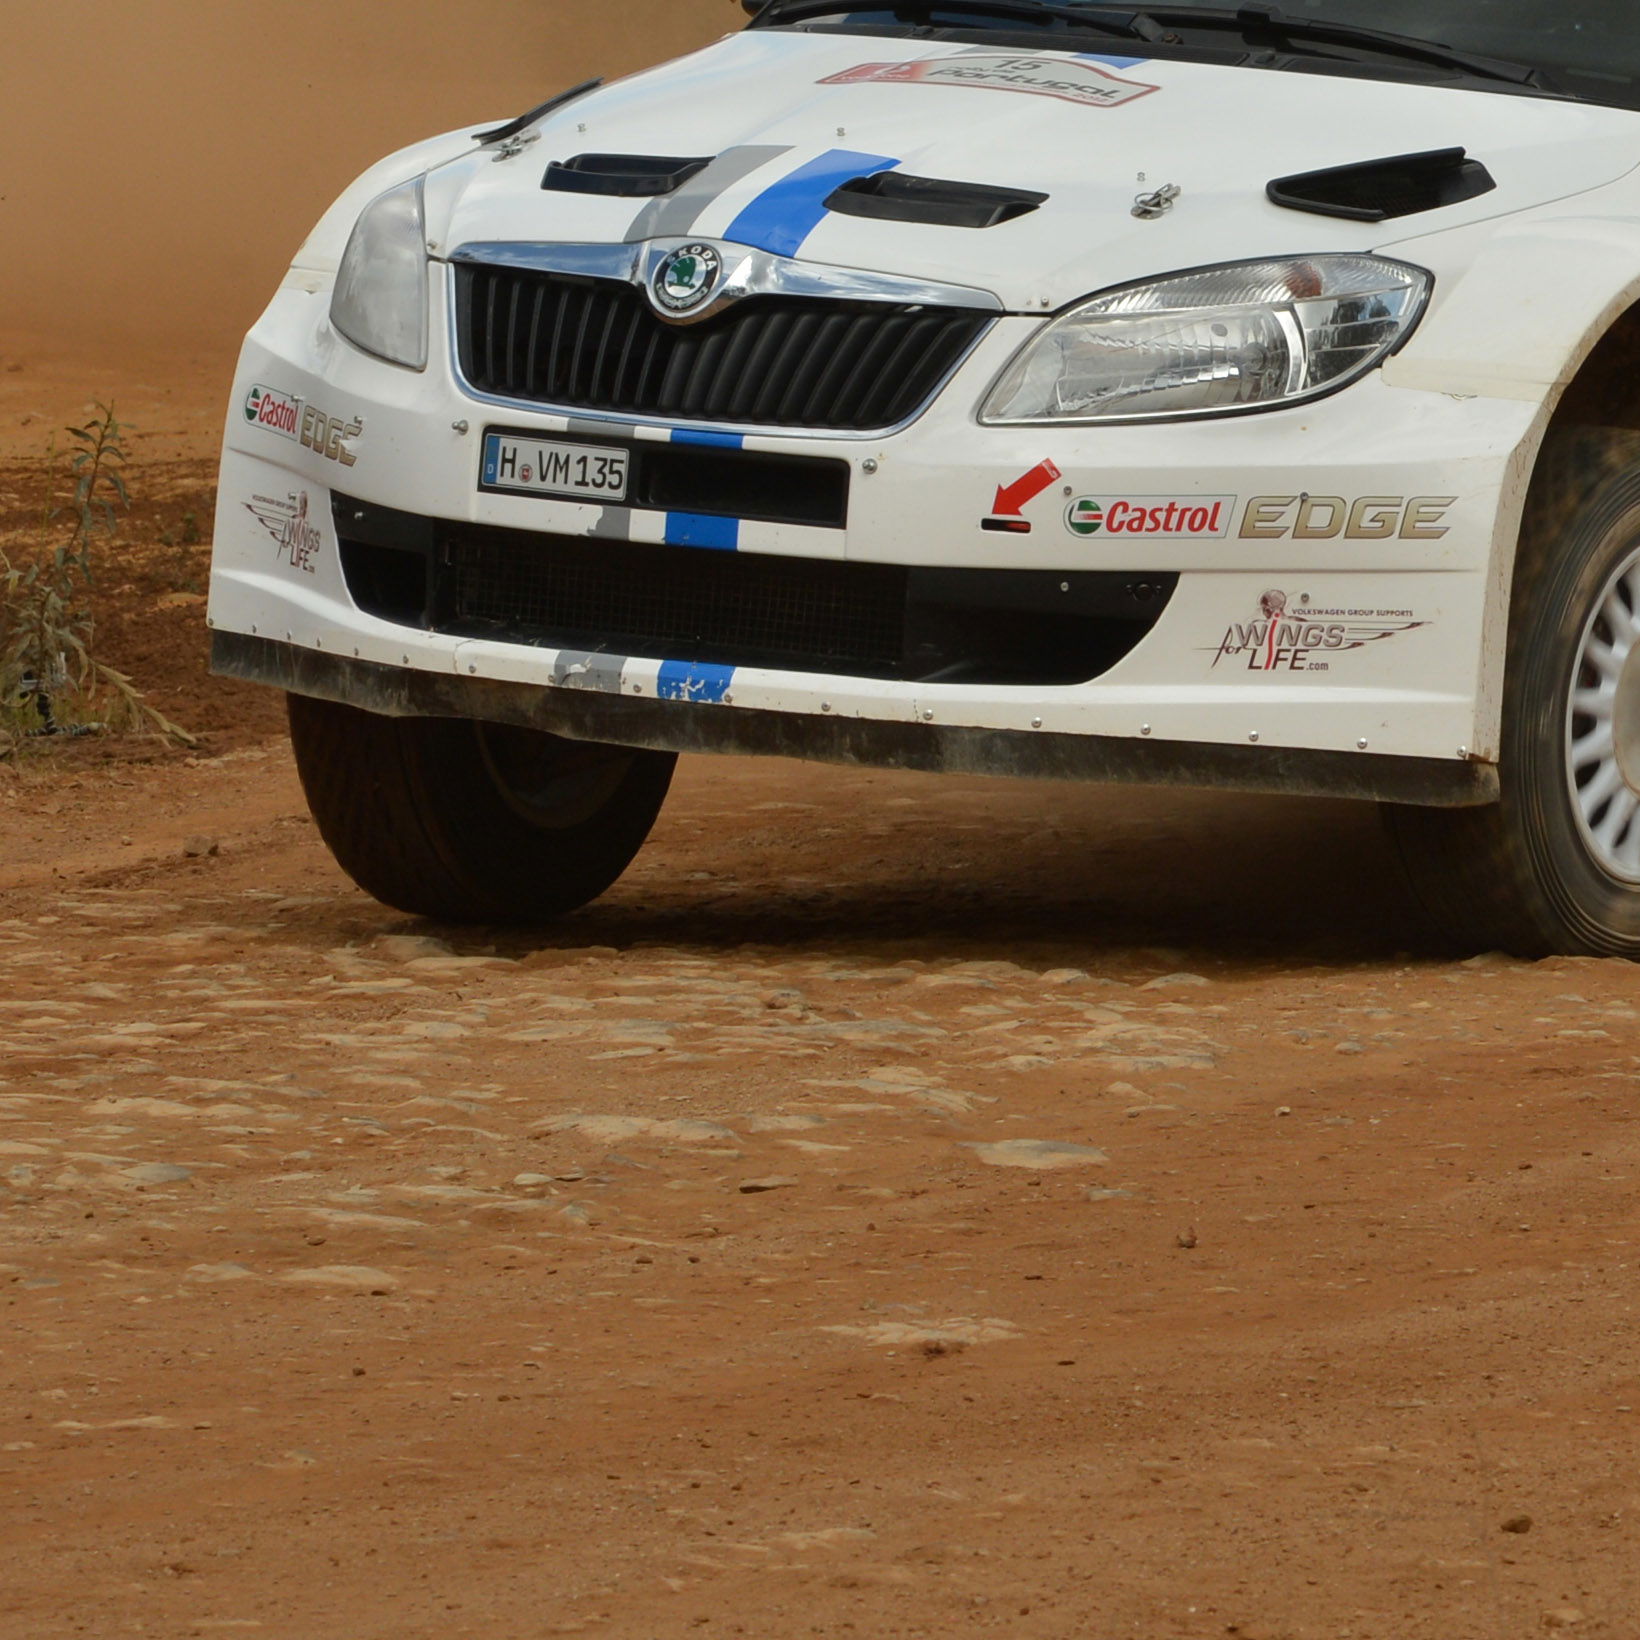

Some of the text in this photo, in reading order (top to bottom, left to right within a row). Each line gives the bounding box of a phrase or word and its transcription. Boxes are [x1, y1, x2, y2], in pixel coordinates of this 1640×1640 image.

[994, 58, 1052, 72] 15
[258, 392, 363, 468] Castrol EDGE
[487, 463, 494, 475] D
[500, 445, 625, 491] H VM 135
[1105, 495, 1460, 540] Castrol EDGE
[1292, 607, 1414, 618] VOLKSWAGEN GROUP SUPPORTS
